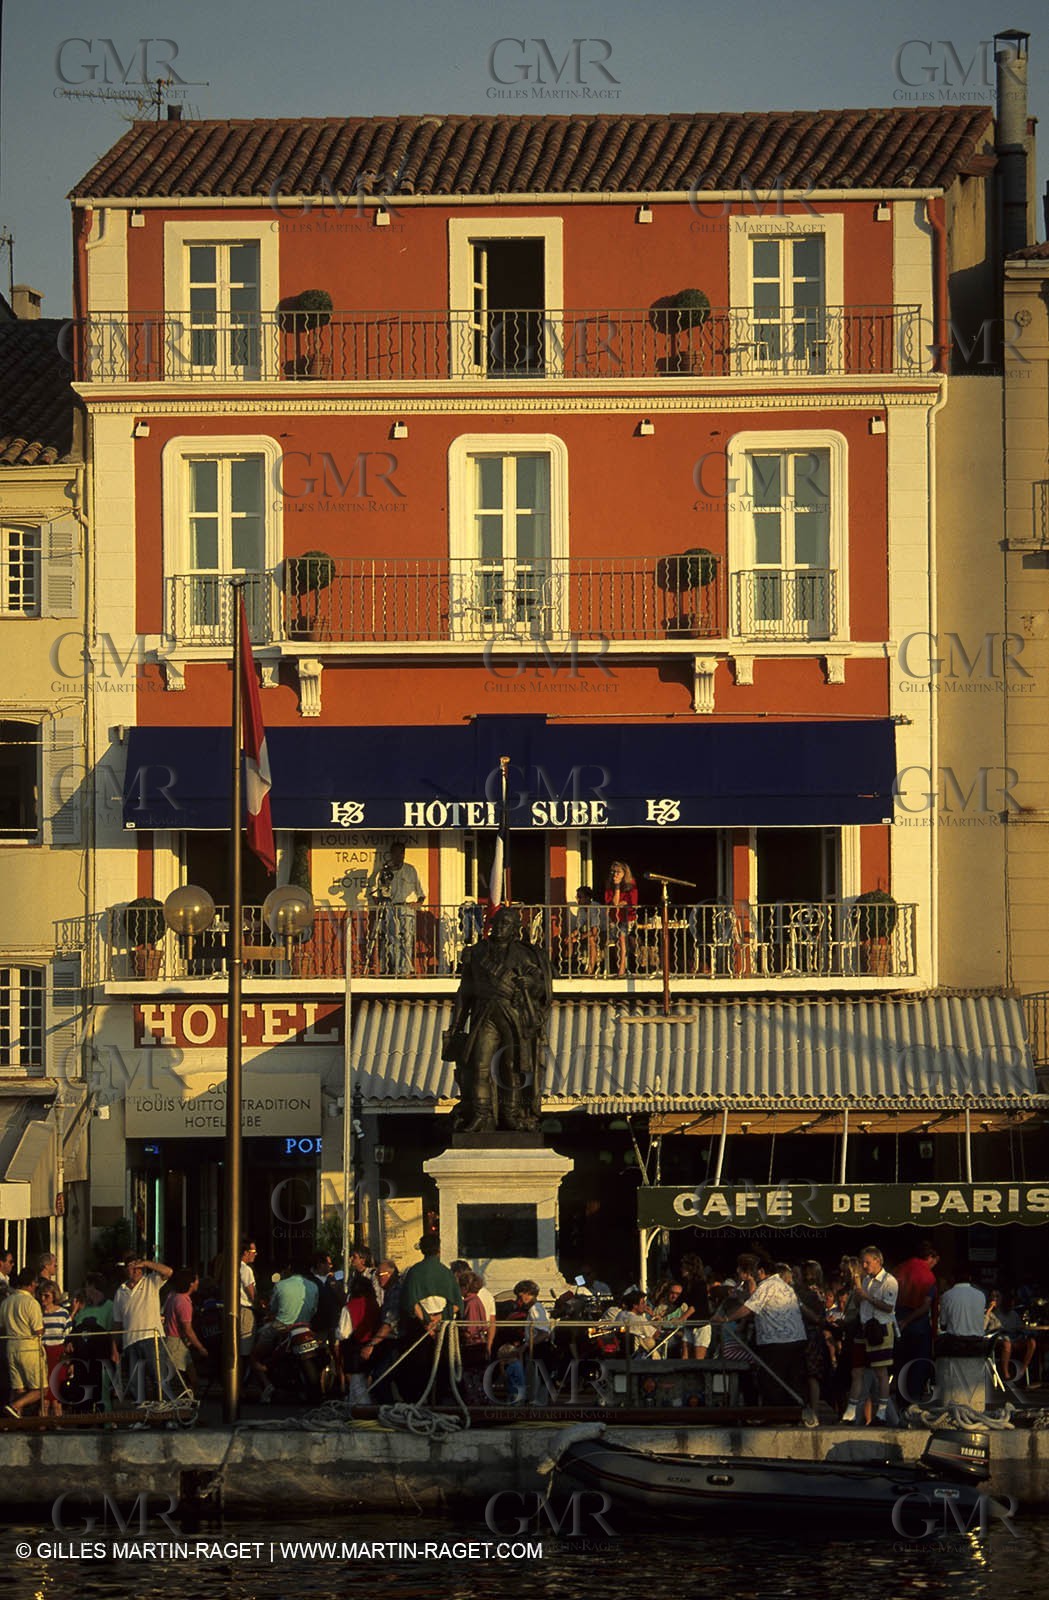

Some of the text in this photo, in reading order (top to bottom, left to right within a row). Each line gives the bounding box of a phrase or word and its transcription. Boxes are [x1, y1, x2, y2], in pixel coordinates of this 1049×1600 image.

[531, 800, 608, 826] SUBE
[321, 834, 419, 846] LOUIS VUITTON
[335, 851, 393, 863] TRADITIO
[140, 1004, 339, 1045] HOTEL
[136, 1099, 311, 1112] LOUIS VUITTO TRADITION
[185, 1116, 226, 1128] HOTEL
[832, 1193, 871, 1213] DE
[910, 1188, 1049, 1214] PARIS
[961, 1447, 985, 1458] YAMAHA
